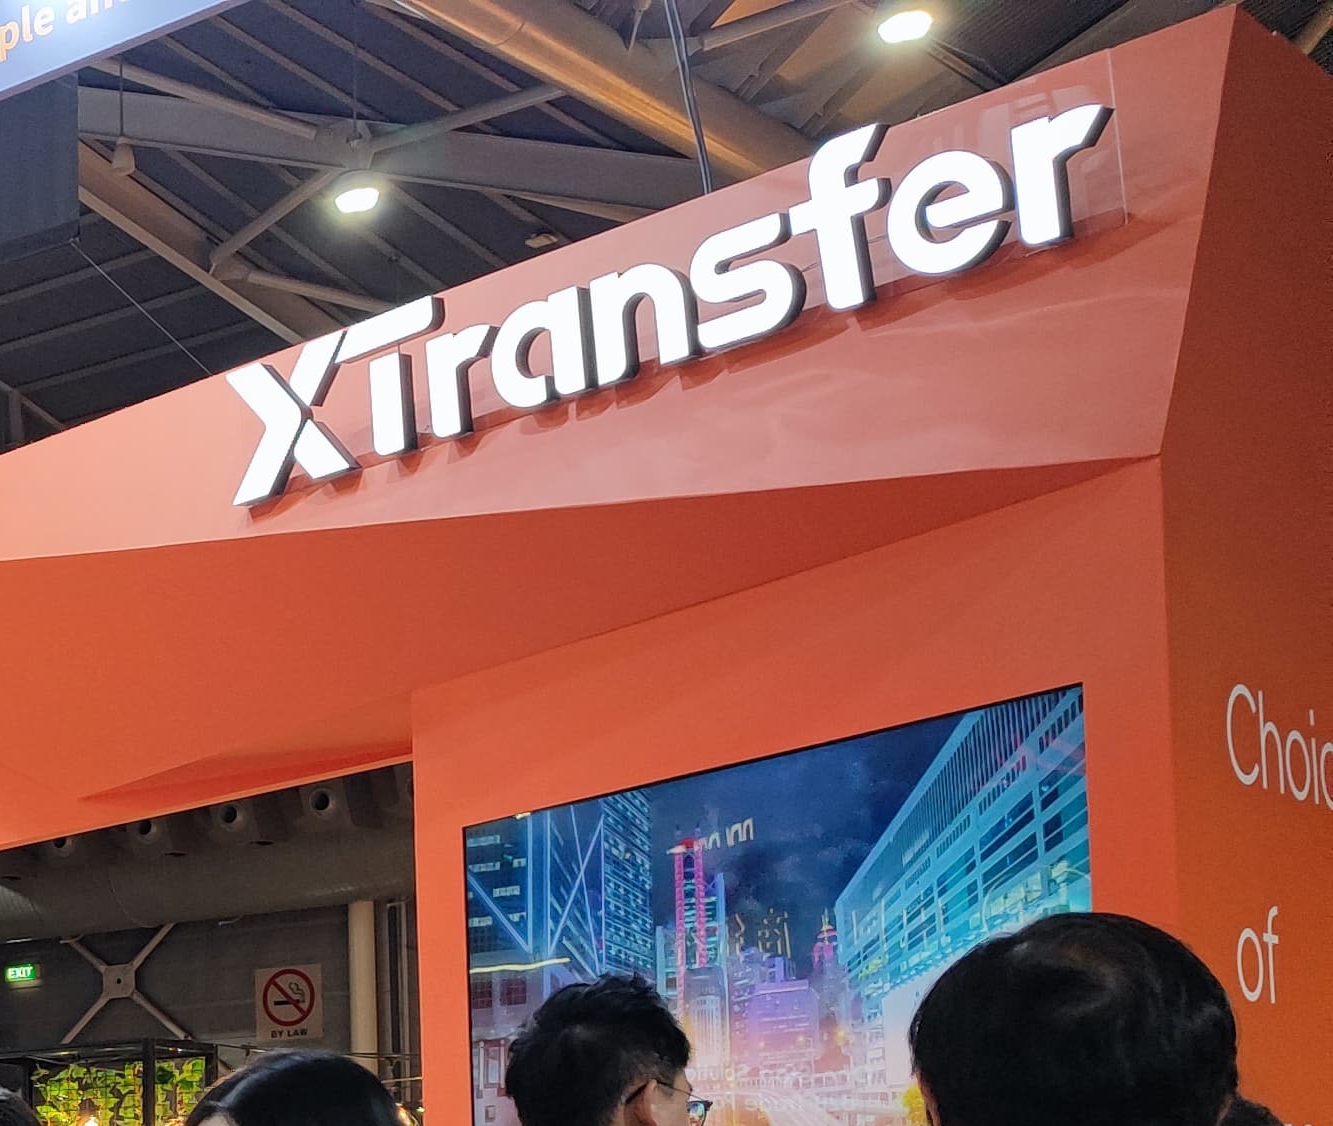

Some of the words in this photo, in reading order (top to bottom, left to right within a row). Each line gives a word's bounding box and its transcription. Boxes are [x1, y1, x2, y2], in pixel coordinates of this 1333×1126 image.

[226, 102, 1115, 507] XTransfer
[7, 966, 34, 980] EXIT
[1236, 905, 1280, 1005] of
[270, 1030, 284, 1039] BY
[287, 1028, 309, 1038] LAW
